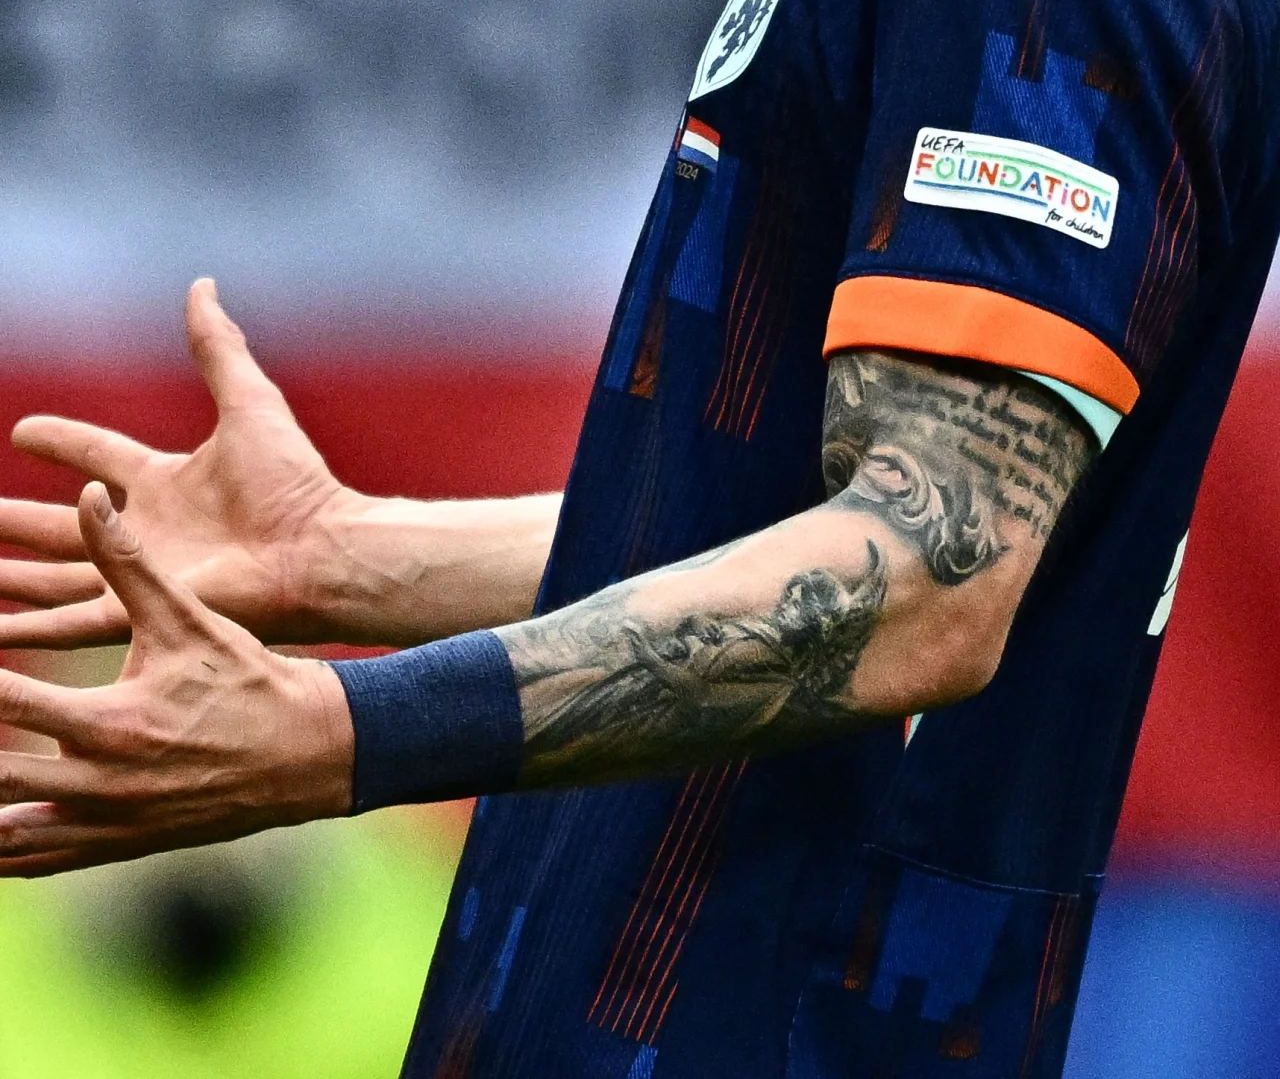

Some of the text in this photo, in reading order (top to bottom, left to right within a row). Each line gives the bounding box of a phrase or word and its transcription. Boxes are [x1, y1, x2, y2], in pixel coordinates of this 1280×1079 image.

[921, 134, 965, 153] UEFA
[1044, 207, 1104, 241] for children
